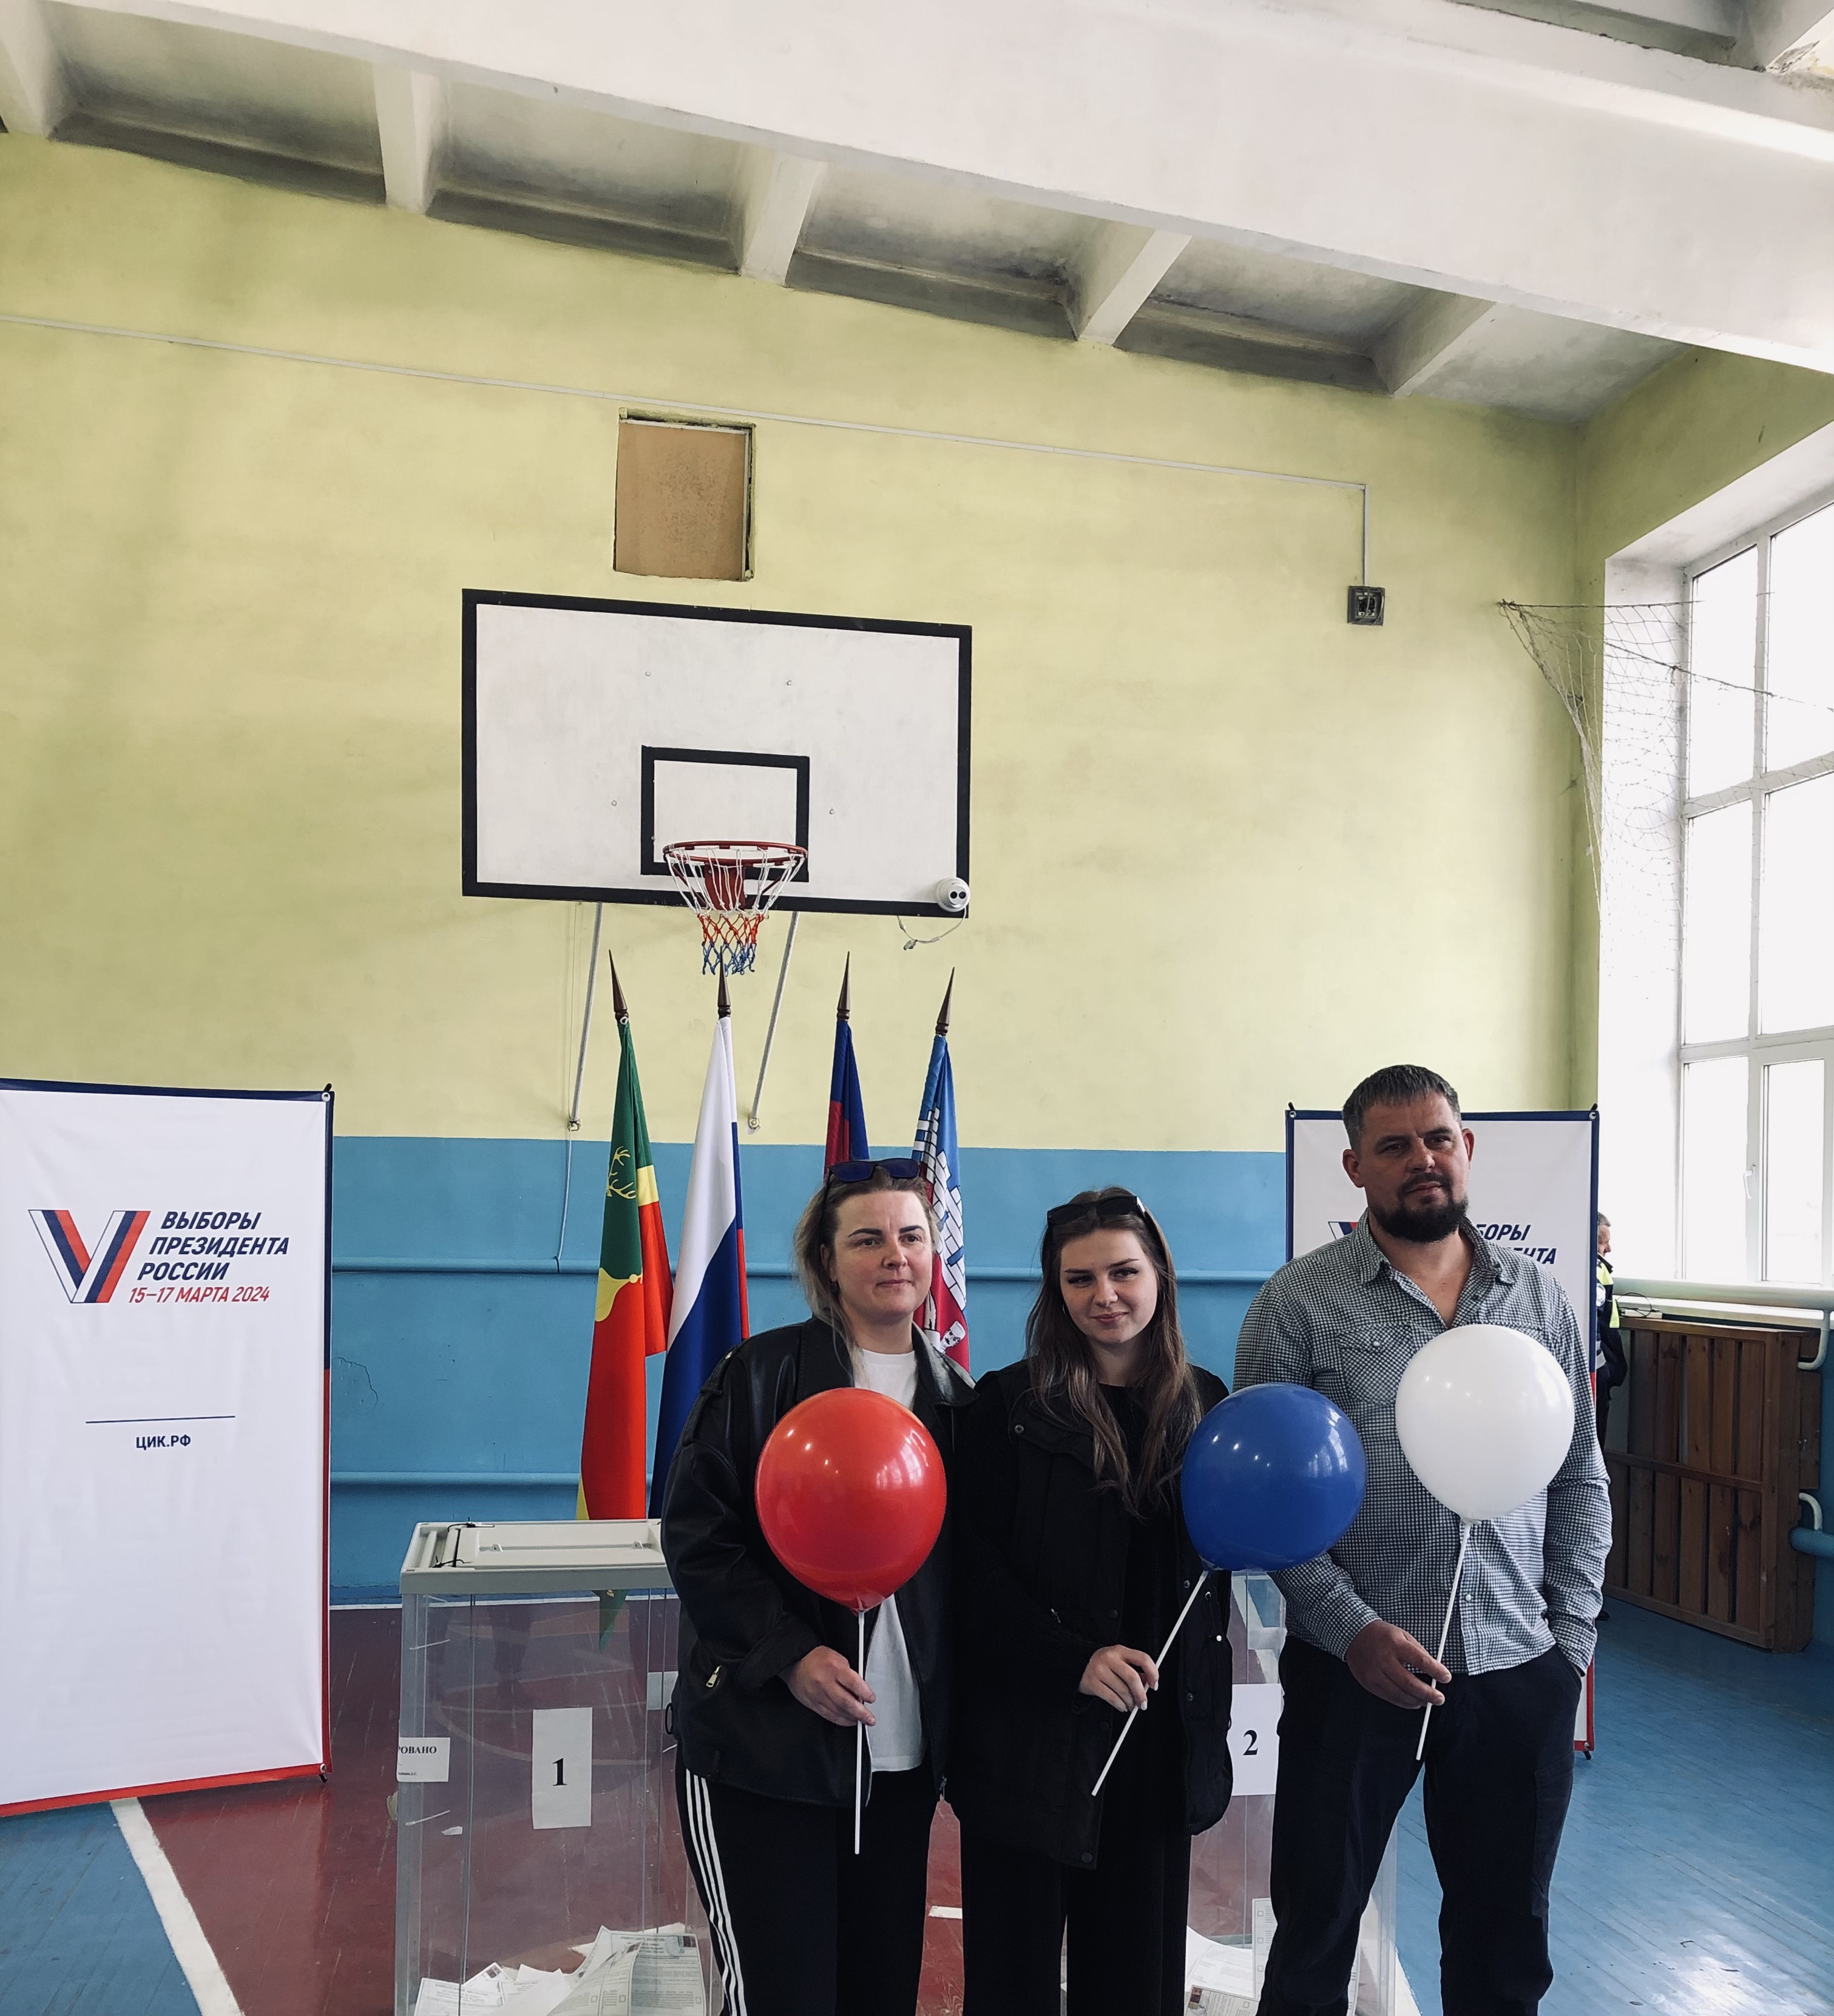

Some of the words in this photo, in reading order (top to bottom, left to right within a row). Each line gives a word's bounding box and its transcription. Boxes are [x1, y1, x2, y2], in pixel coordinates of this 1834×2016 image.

[160, 1211, 262, 1230] ВЫБОРЫ
[1477, 1223, 1531, 1241] БОРЫ
[149, 1236, 289, 1258] ПРЕЗИДЕНТА
[137, 1262, 231, 1281] РОССИИ
[175, 1286, 230, 1303] МАРТА
[231, 1286, 270, 1302] 2024
[136, 1434, 191, 1451] ЦИК.РФ
[1242, 1730, 1258, 1756] 2
[552, 1757, 567, 1787] 1
